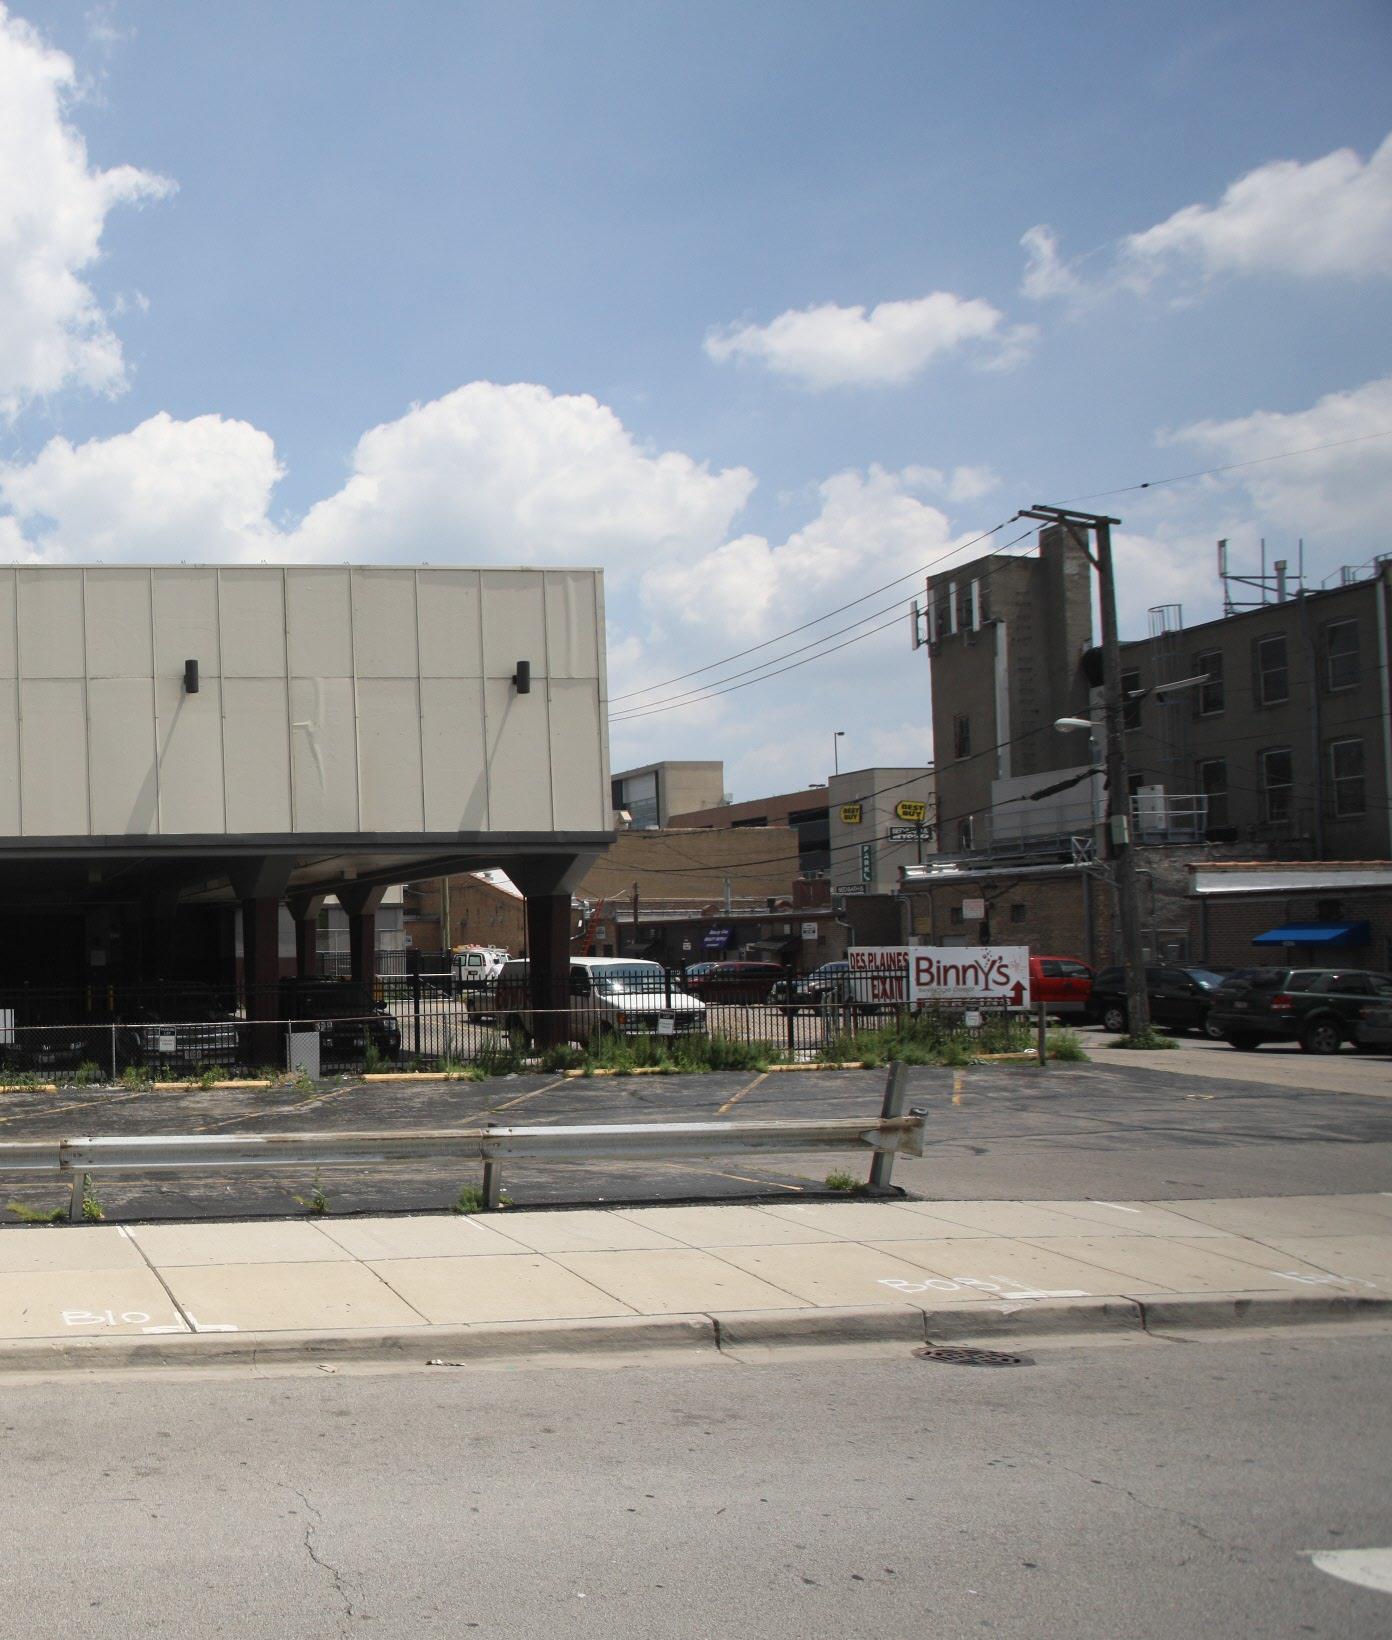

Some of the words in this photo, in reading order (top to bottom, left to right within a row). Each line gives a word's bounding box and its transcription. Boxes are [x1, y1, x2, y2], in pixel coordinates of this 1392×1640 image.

[901, 803, 925, 811] BEST
[850, 952, 867, 970] DES
[868, 951, 909, 970] PLAINES
